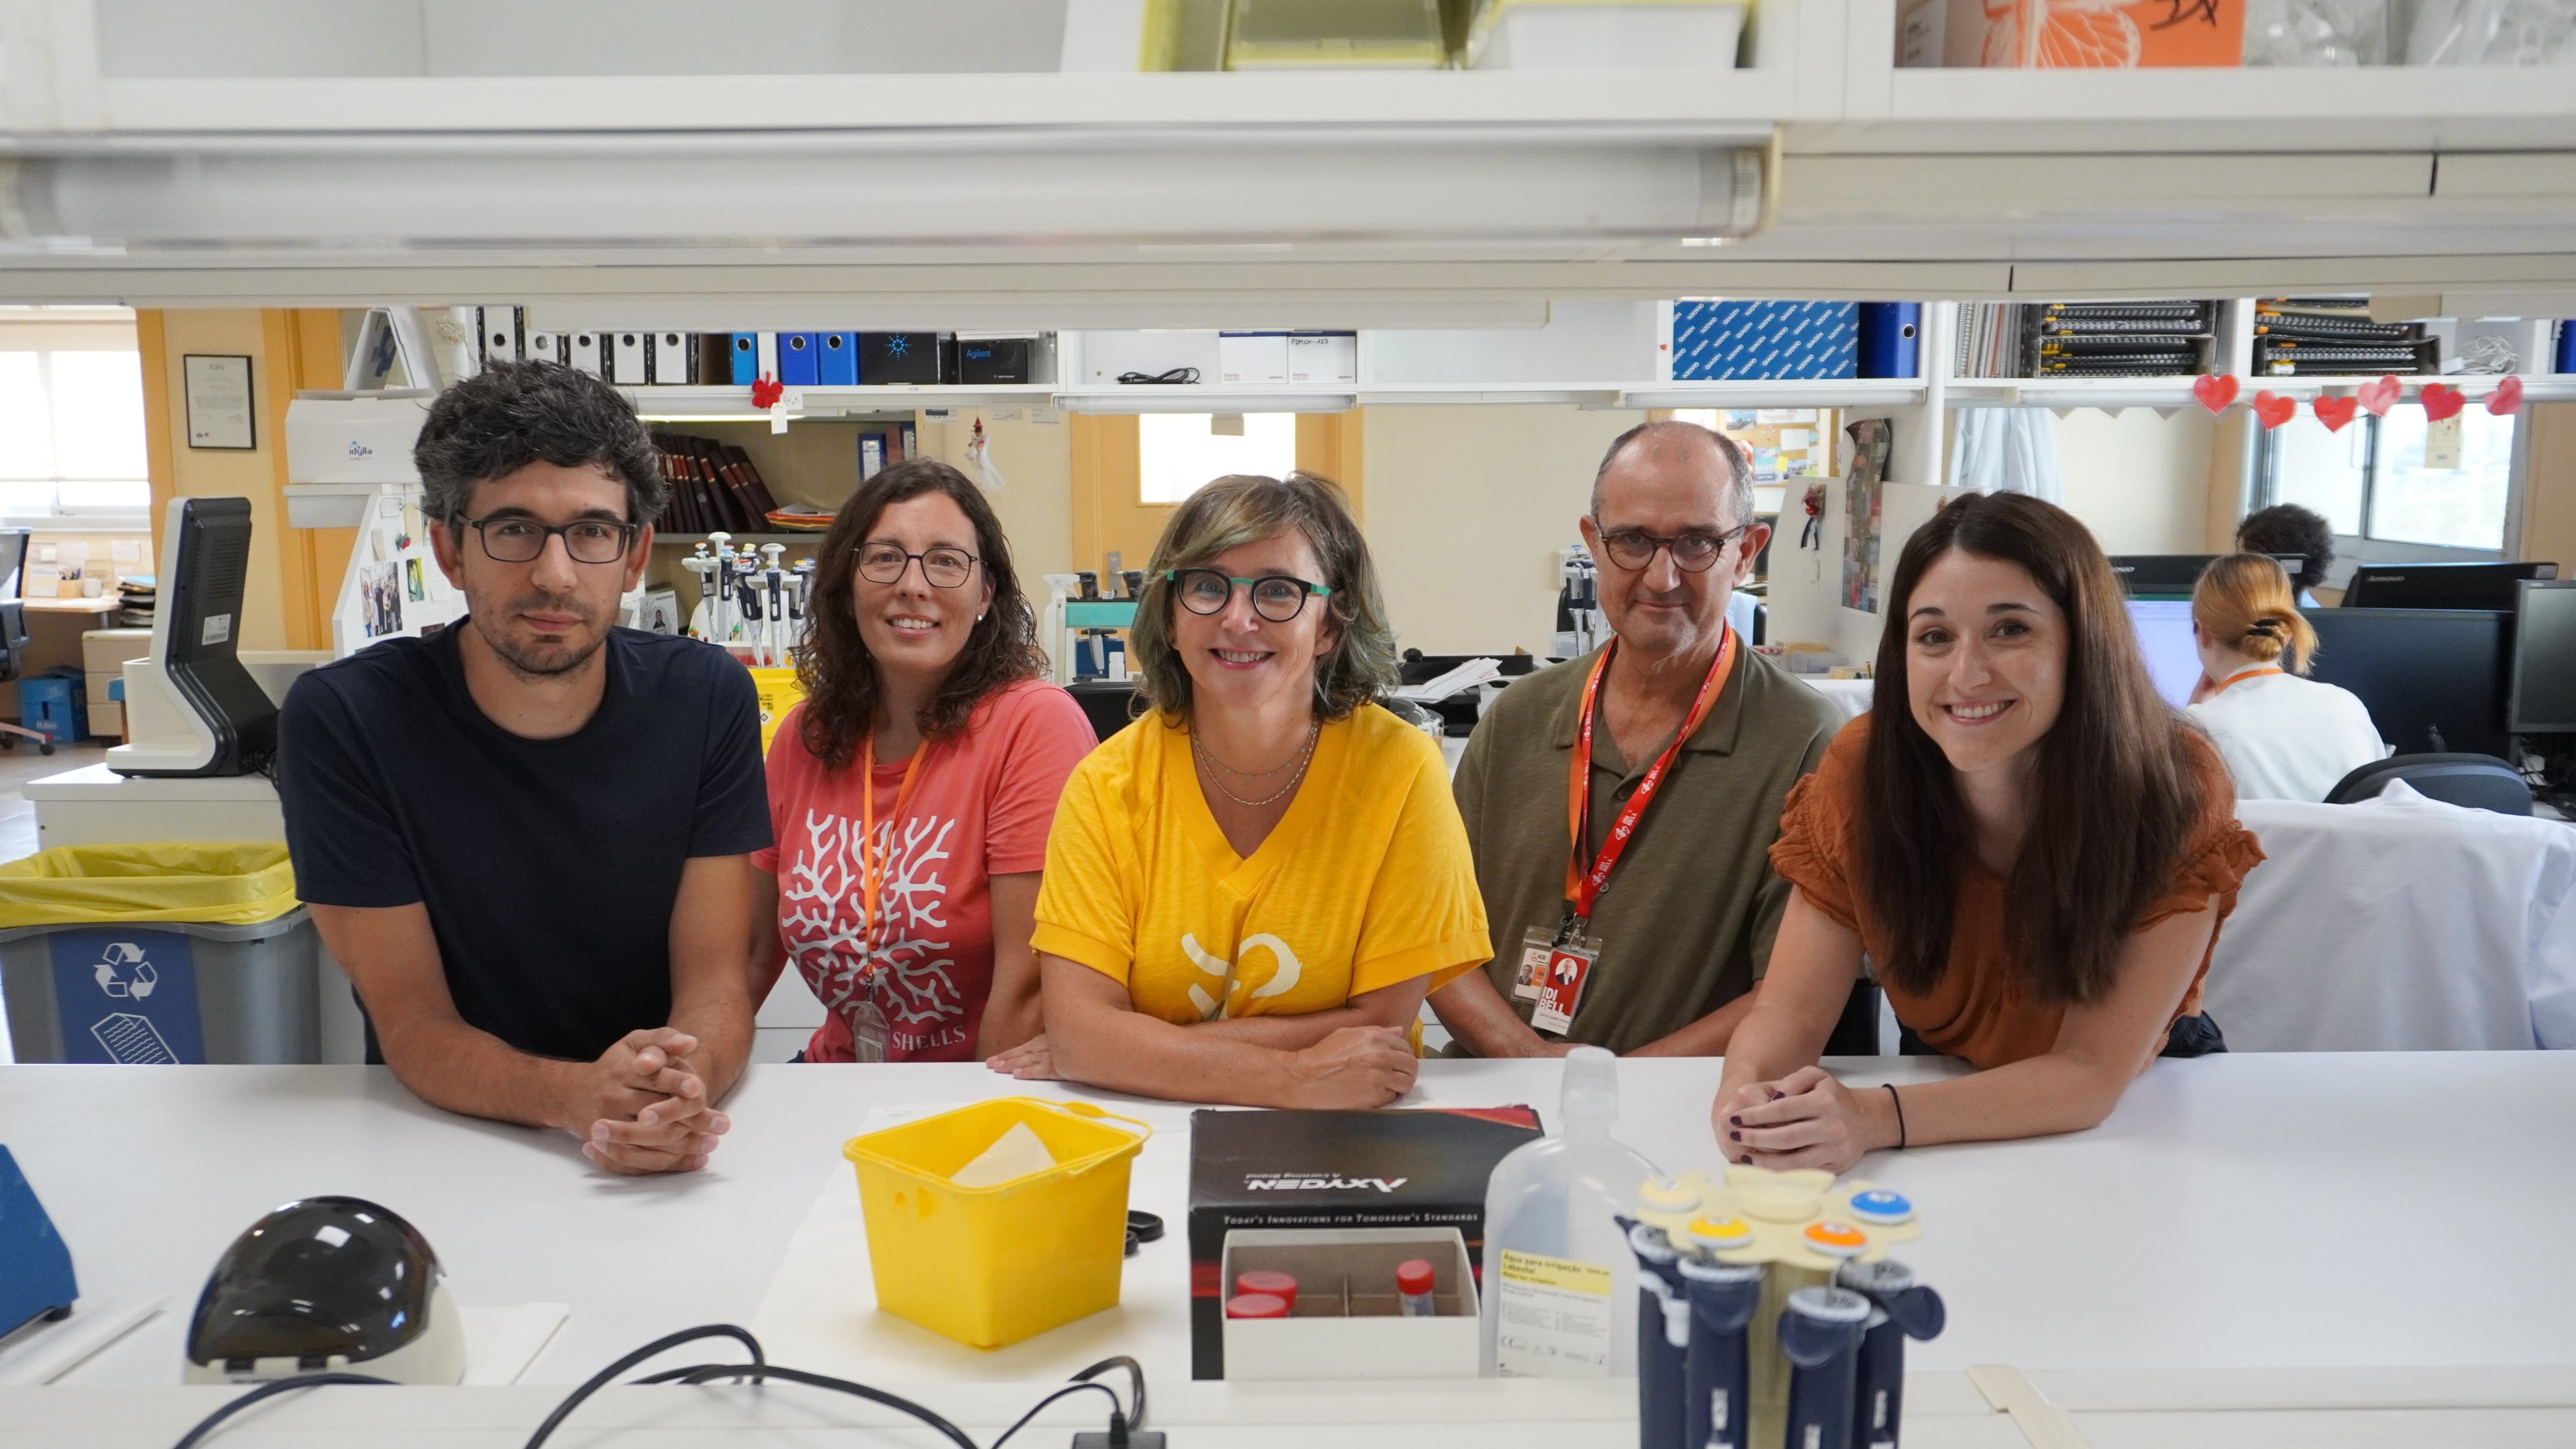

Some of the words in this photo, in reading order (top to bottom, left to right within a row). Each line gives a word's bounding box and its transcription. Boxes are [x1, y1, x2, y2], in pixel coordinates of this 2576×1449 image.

[1687, 303, 1704, 320] QIAGEN
[1723, 308, 1740, 325] QIAGEN
[1781, 304, 1798, 321] QIAGEN
[1815, 310, 1832, 326] QIAGEN
[1700, 317, 1717, 334] QIAGEN
[1758, 313, 1775, 329] QIAGEN
[1794, 318, 1810, 334] QIAGEN
[1679, 326, 1695, 342] QIAGEN
[1736, 322, 1753, 338] QIAGEN
[1771, 327, 1788, 343] QIAGEN
[1828, 324, 1845, 339] QIAGEN
[1714, 331, 1730, 347] QIAGEN
[1749, 336, 1766, 352] QIAGEN
[1807, 332, 1824, 348] QIAGEN
[1841, 337, 1858, 353] QIAGEN
[966, 349, 991, 359] Agilent
[1692, 339, 1708, 356] QIAGEN
[1727, 345, 1744, 360] QIAGEN
[1784, 341, 1801, 357] QIAGEN
[1819, 346, 1837, 362] QIAGEN
[1705, 353, 1721, 369] QIAGEN
[1763, 349, 1779, 366] QIAGEN
[1797, 355, 1814, 371] QIAGEN
[1682, 362, 1699, 379] QIAGEN
[1740, 359, 1756, 374] QIAGEN
[1776, 363, 1792, 379] QIAGEN
[1833, 359, 1849, 376] QIAGEN
[349, 446, 372, 456] idylla
[1542, 986, 1559, 1001] IDI
[1538, 997, 1564, 1015] BELL
[892, 1026, 966, 1051] SHELLS
[1247, 1178, 1408, 1193] AXYGEN
